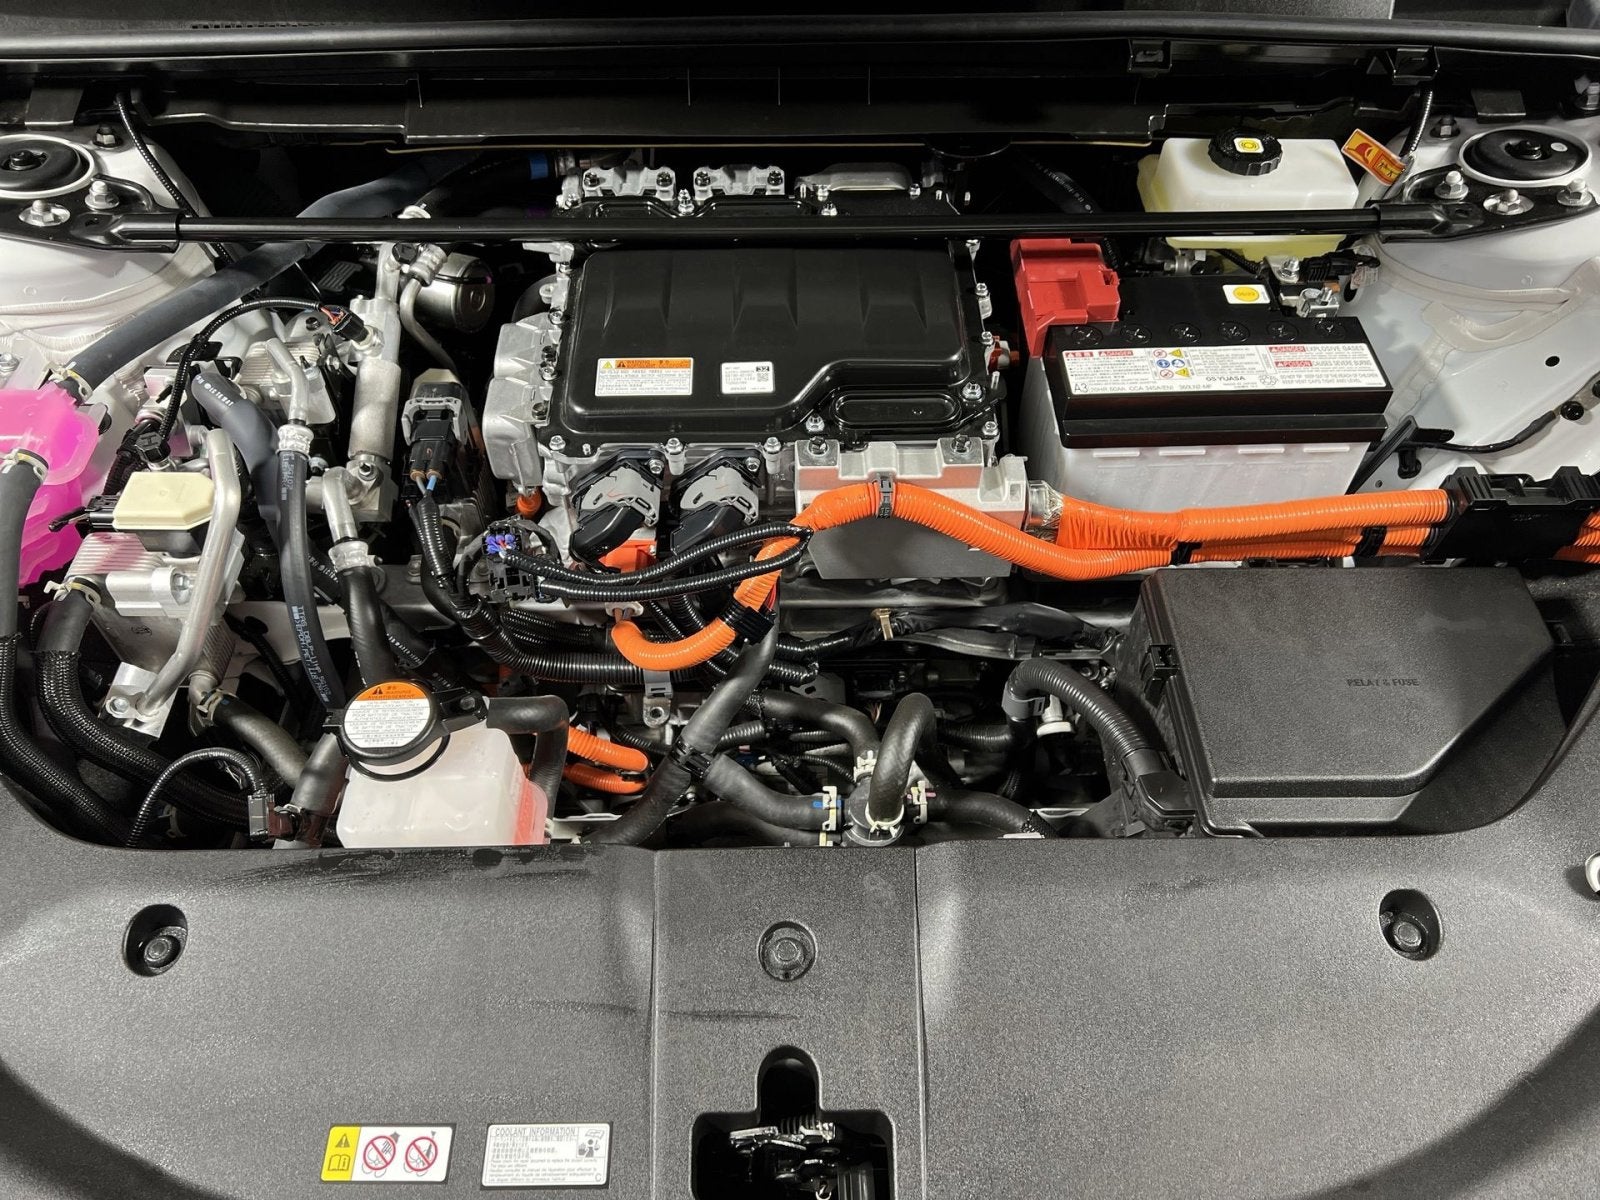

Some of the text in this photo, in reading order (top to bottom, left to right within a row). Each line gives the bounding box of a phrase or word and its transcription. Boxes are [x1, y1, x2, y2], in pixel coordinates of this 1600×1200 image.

[1074, 383, 1089, 393] A3
[495, 1127, 576, 1137] COOLANT INFORMATION
